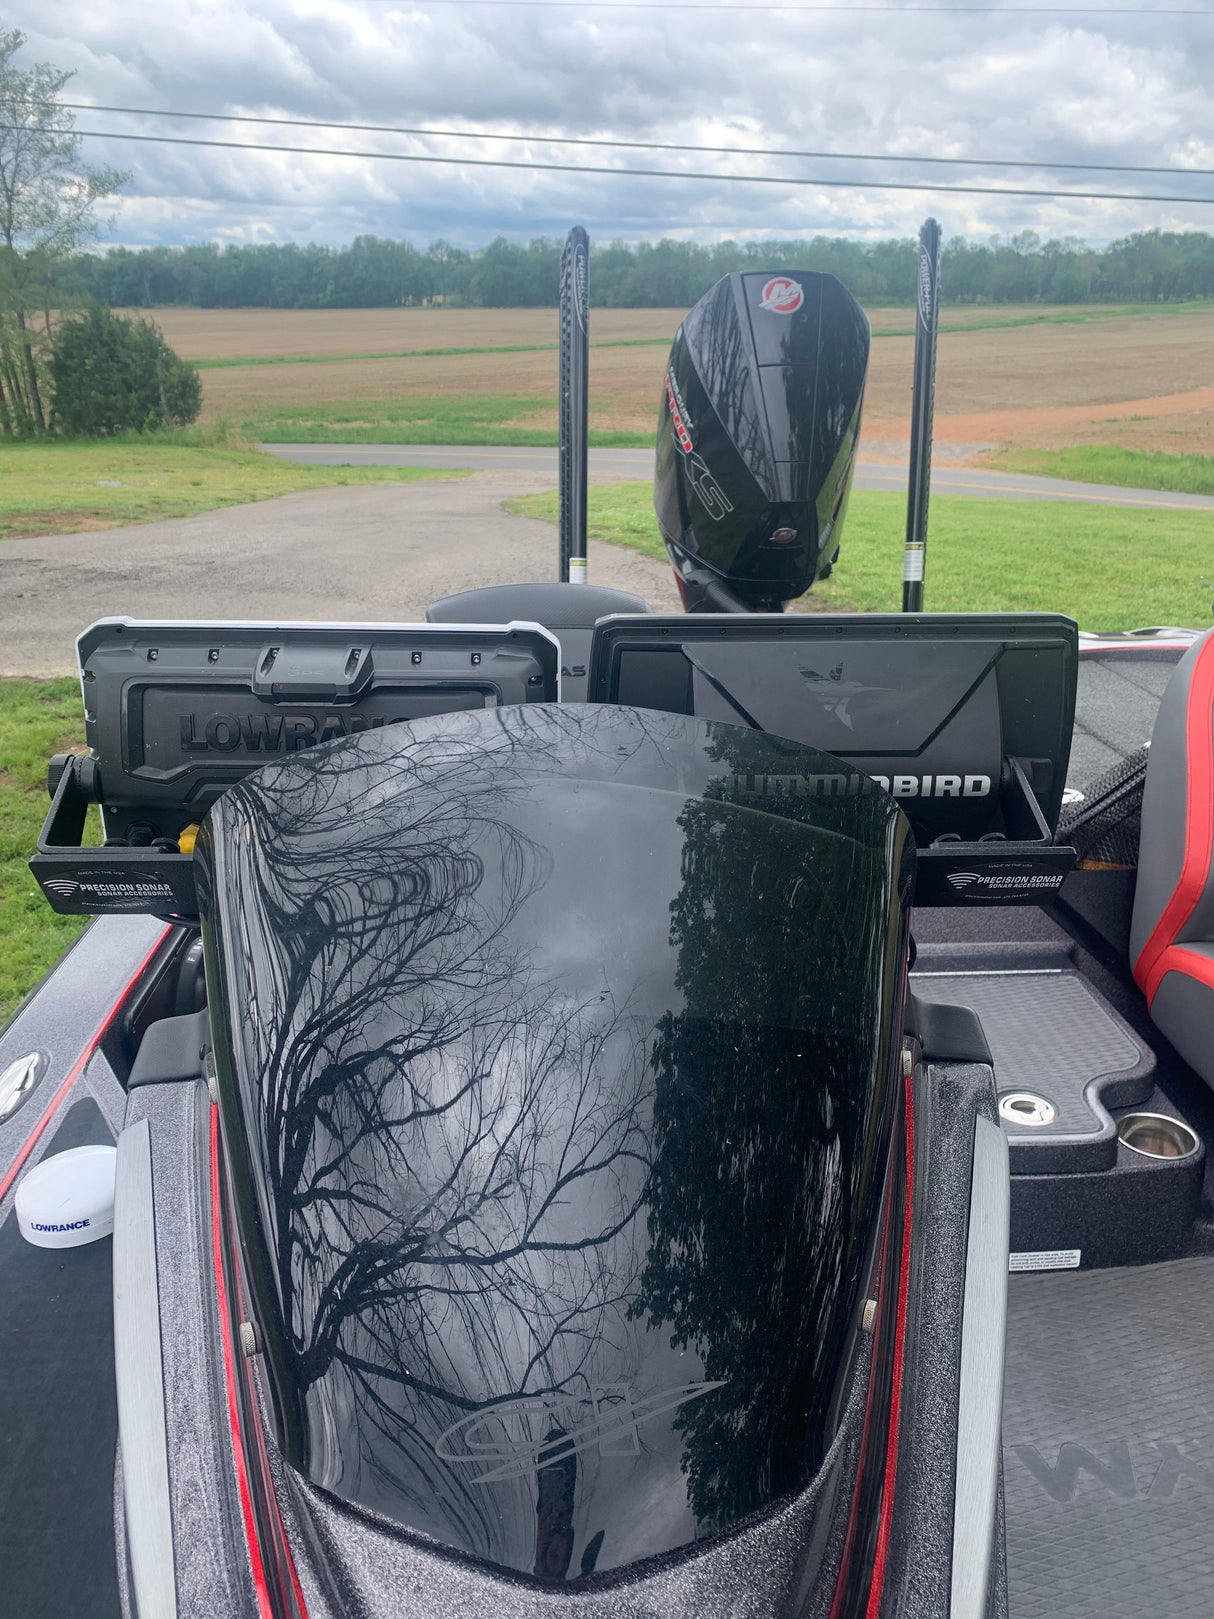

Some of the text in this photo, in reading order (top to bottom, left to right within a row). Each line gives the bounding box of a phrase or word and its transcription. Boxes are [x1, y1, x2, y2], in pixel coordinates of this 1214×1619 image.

[179, 712, 411, 753] LOWRA
[977, 875, 1064, 884] PRECISION SONAR
[80, 883, 171, 892] PRECISION SONAR
[30, 1218, 91, 1232] LOWRANCE
